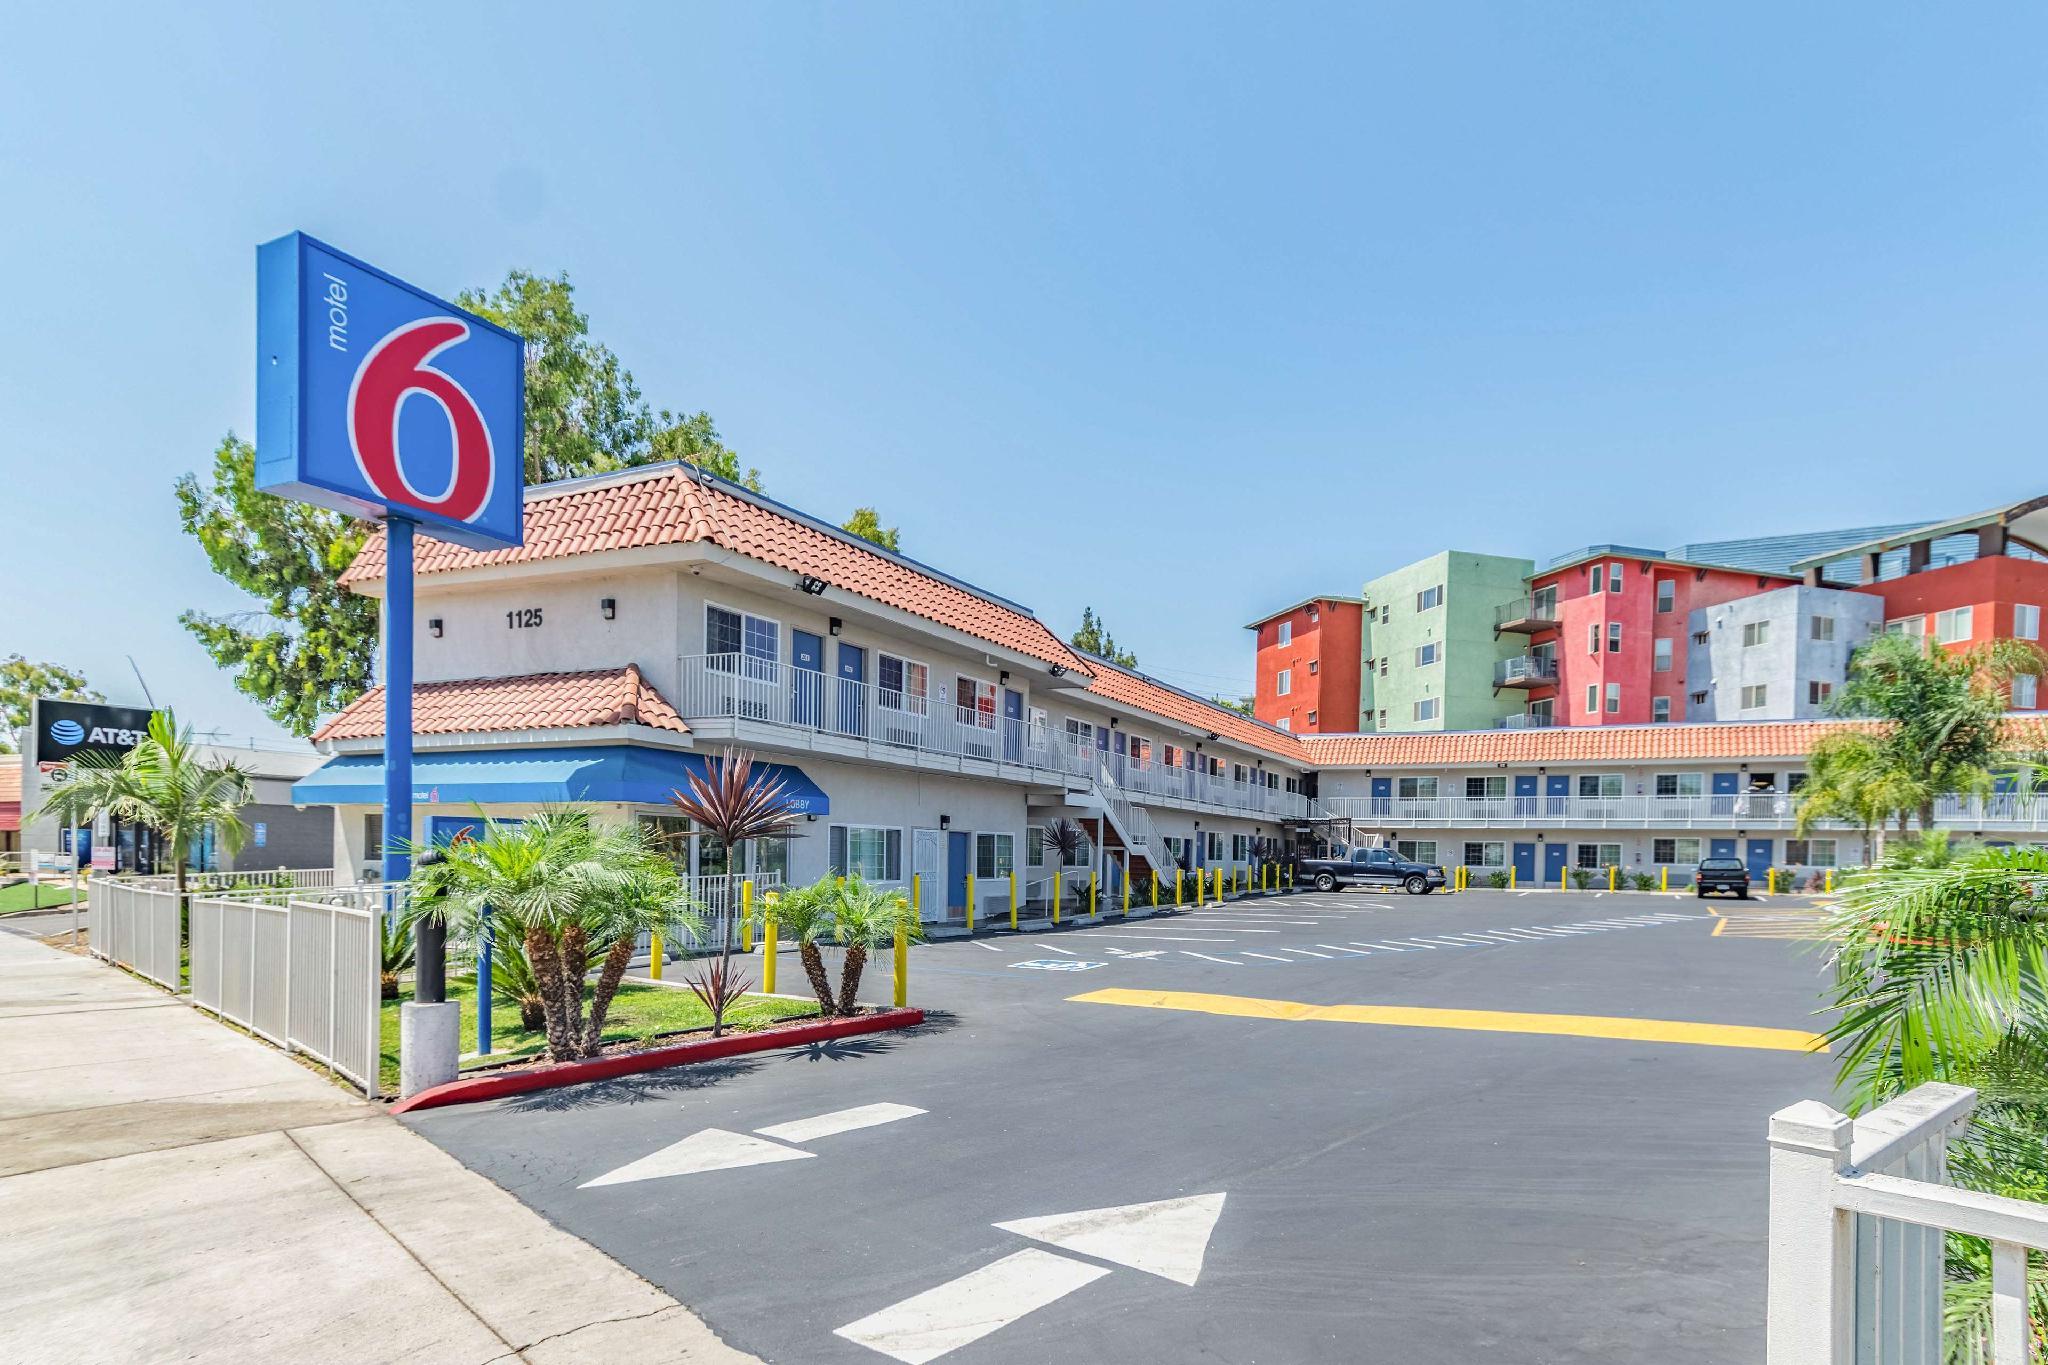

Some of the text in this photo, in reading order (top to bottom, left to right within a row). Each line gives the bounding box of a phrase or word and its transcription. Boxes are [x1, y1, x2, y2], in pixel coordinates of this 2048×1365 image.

[323, 272, 348, 352] motel
[347, 316, 496, 524] 6
[506, 608, 543, 629] 1125
[87, 727, 148, 746] AT&T
[786, 799, 809, 809] LOBBY
